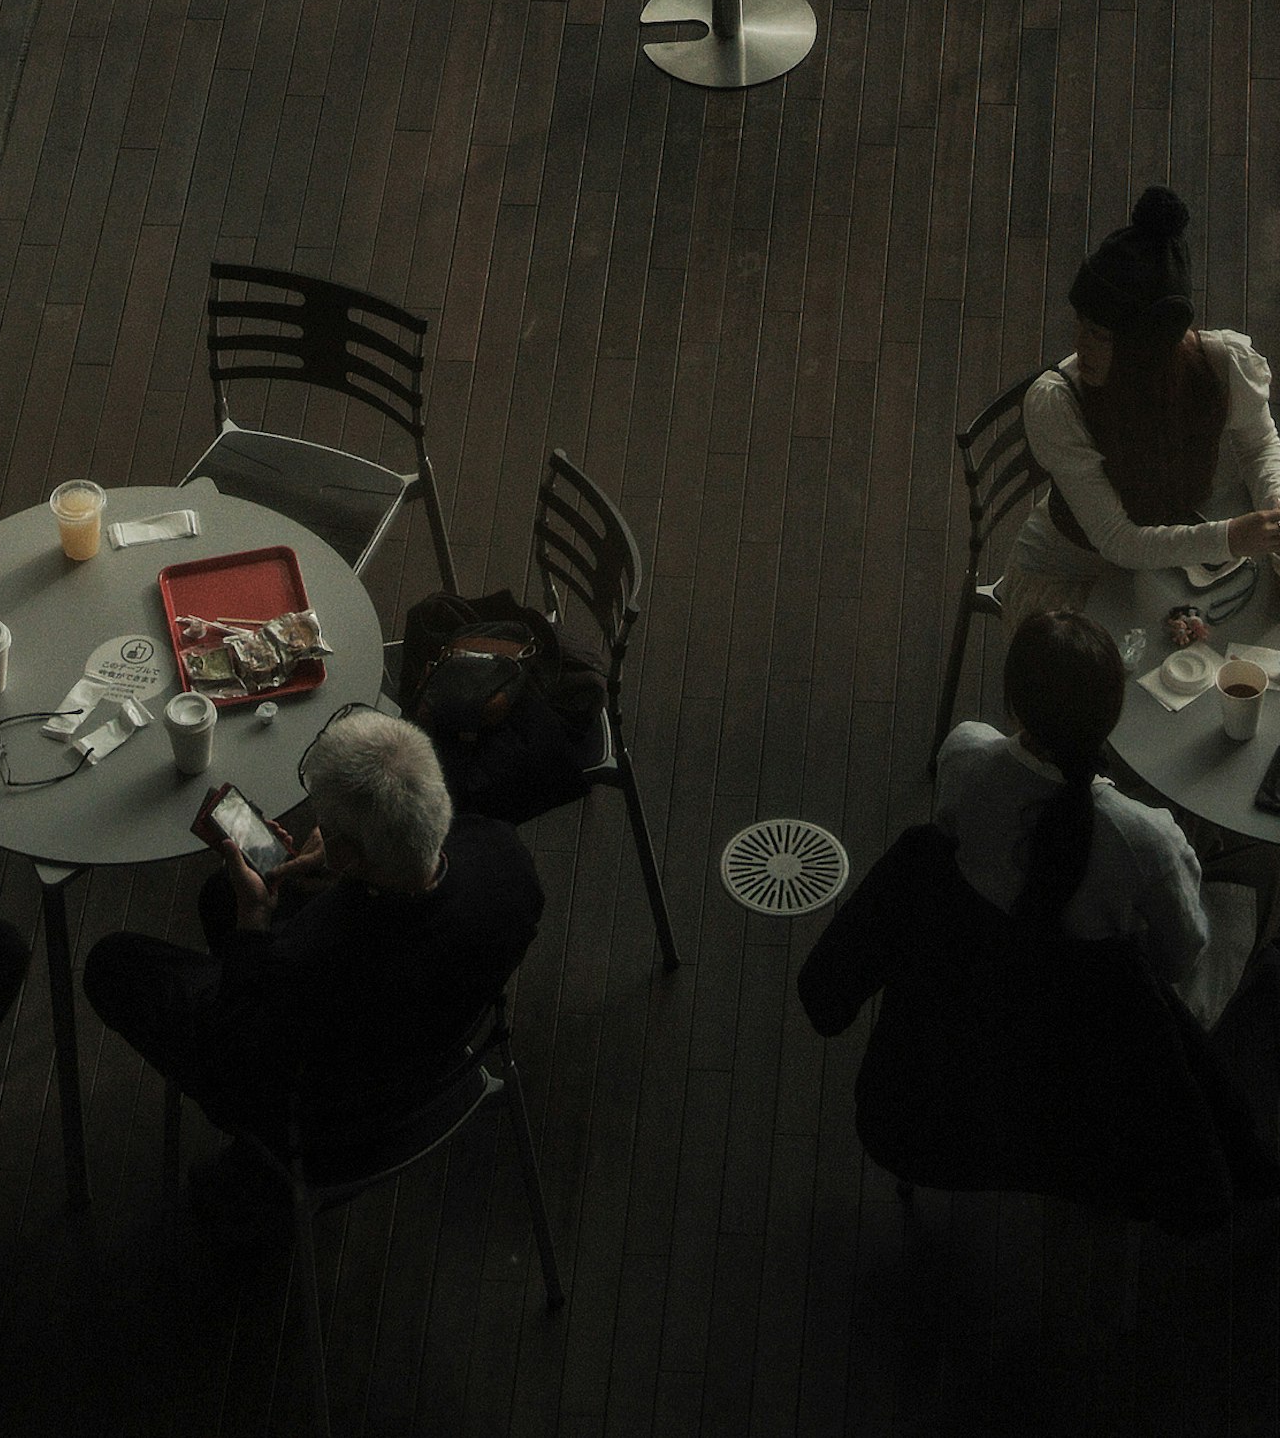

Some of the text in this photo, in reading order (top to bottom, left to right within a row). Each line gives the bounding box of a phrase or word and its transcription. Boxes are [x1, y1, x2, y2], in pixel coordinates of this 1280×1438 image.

[101, 660, 161, 676] このテーブルで
